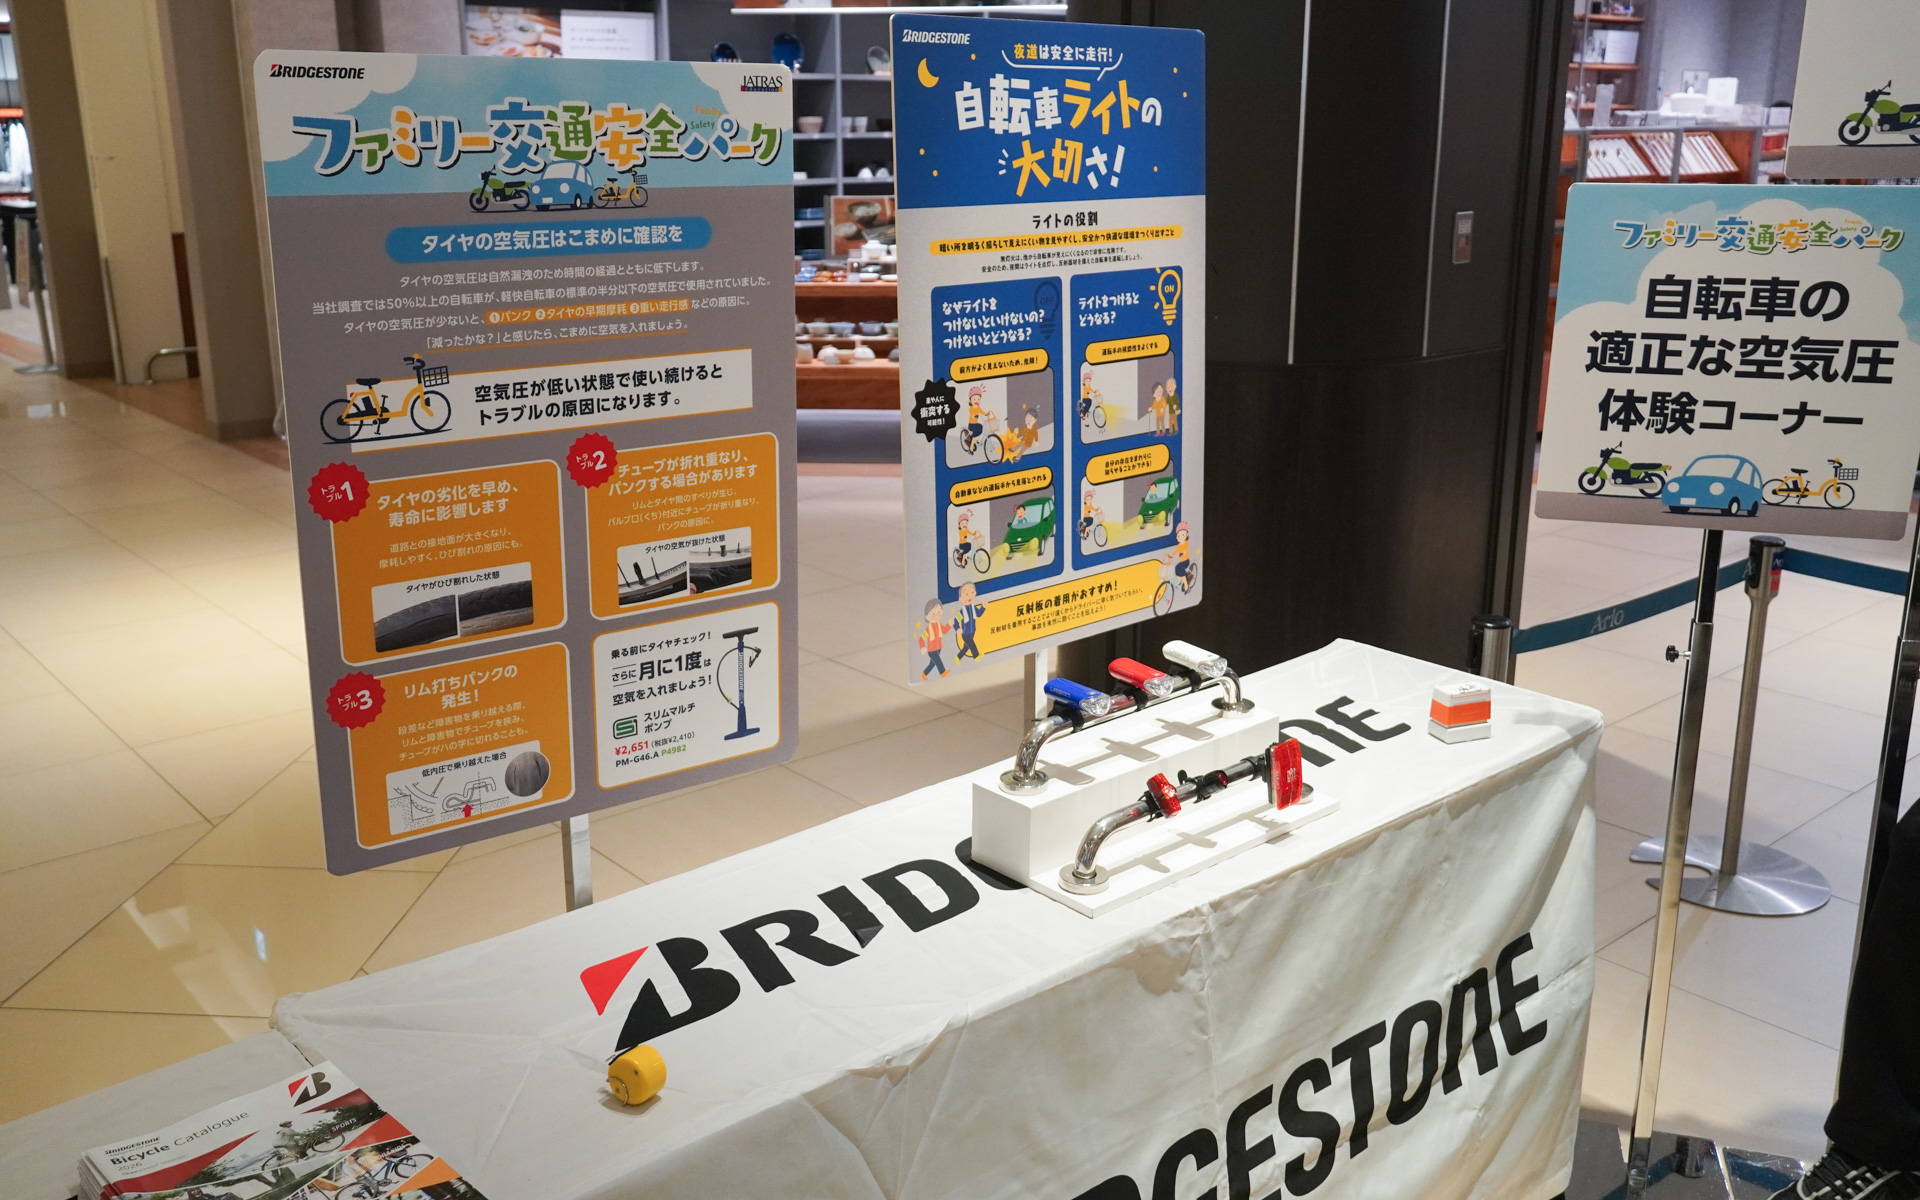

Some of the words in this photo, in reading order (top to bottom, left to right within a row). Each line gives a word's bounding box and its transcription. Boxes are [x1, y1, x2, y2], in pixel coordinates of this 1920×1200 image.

[902, 28, 970, 45] BRIDGESTONE
[1013, 43, 1113, 62] 夜道は安全に走行！
[269, 63, 365, 80] BRIDGESTONE
[741, 75, 783, 88] JATRAS
[695, 104, 722, 118] Family
[955, 73, 1162, 136] 自転車ライトの
[292, 99, 782, 174] ファミリー交通安全パーク
[1012, 138, 1125, 197] 大切さ！
[1032, 210, 1098, 229] ライトの役割
[421, 225, 682, 256] タイヤの空気圧はこまめに確認を
[1614, 216, 1904, 254] ファミリー交通安全パーク
[400, 261, 705, 289] タイヤの空気圧は自然漏洩のため時間の経過とともに低下します。
[312, 276, 772, 315] 当社調査では50%以上の自転車が、軽快自転車の標準の半分以下の空気圧で使用されていました。
[1078, 292, 1139, 310] ライトをつけると
[1164, 284, 1175, 294] ON
[1645, 274, 1850, 322] 自転車の
[343, 312, 485, 335] タイヤの空気圧が少ないと、
[691, 296, 751, 309] などの原因に。
[942, 297, 997, 315] なぜライトを
[1078, 311, 1117, 327] どうなる？
[943, 309, 1045, 332] つけないといけないの？
[425, 320, 688, 350] 「減ったかな？」と感じたら、こまめに空気を入れましょう。
[943, 328, 1032, 349] つけないとどうなる？
[1585, 330, 1899, 384] 適正な空気圧
[474, 363, 723, 403] 空気圧が低い状態で使い続けると
[478, 391, 681, 426] トラブルの原因になります。
[919, 403, 950, 419] 衝突する
[1598, 388, 1864, 435] 体験コーナー
[592, 450, 607, 471] 2
[618, 450, 749, 478] チューブが折れ重なり、
[341, 480, 354, 501] 1
[608, 464, 758, 496] パンクする場合があります
[955, 473, 1046, 499] 自動車などの運転手から見落とされる
[377, 480, 519, 511] タイヤの劣化を早め、
[632, 488, 738, 510] リムとタイヤ間のすべりが生じ、
[388, 497, 509, 528] 寿命に影響します
[657, 516, 715, 532] パンクの原因に。
[390, 527, 512, 554] 道路との接地面が大きくなり、
[645, 534, 726, 554] タイヤの空気が抜けた状態
[379, 540, 523, 569] 摩耗しやすく、ひび割れの原因にも。
[406, 570, 500, 594] タイヤがひび割れした状態
[1016, 580, 1118, 616] 反射板の着用がおすすめ！
[611, 631, 711, 660] 乗る前にタイヤチェック！
[404, 664, 518, 699] リム打ちパンクの
[611, 669, 637, 682] さらに
[357, 689, 373, 710] 3
[441, 688, 479, 710] 発生！
[612, 674, 712, 706] 空気を入れましょう！
[398, 702, 526, 736] 段差など障害物を乗り越える際、
[644, 702, 696, 722] スリムマルチ
[401, 714, 524, 748] リムと障害物でチューブを挟み、
[644, 719, 672, 734] ポンプ
[399, 727, 529, 762] チューブがハの字に切れることも。
[614, 741, 649, 756] ¥2,651
[615, 752, 659, 767] PM-G46.A
[661, 744, 687, 757] P4982
[422, 751, 507, 778] 低内圧で乗り越えた場合
[331, 1117, 357, 1132] SPORTS
[104, 1136, 160, 1156] BRIDGESTONE
[109, 1143, 171, 1167] Bicycle
[173, 1111, 249, 1147] Catalogue
[116, 1160, 143, 1173] 2026
